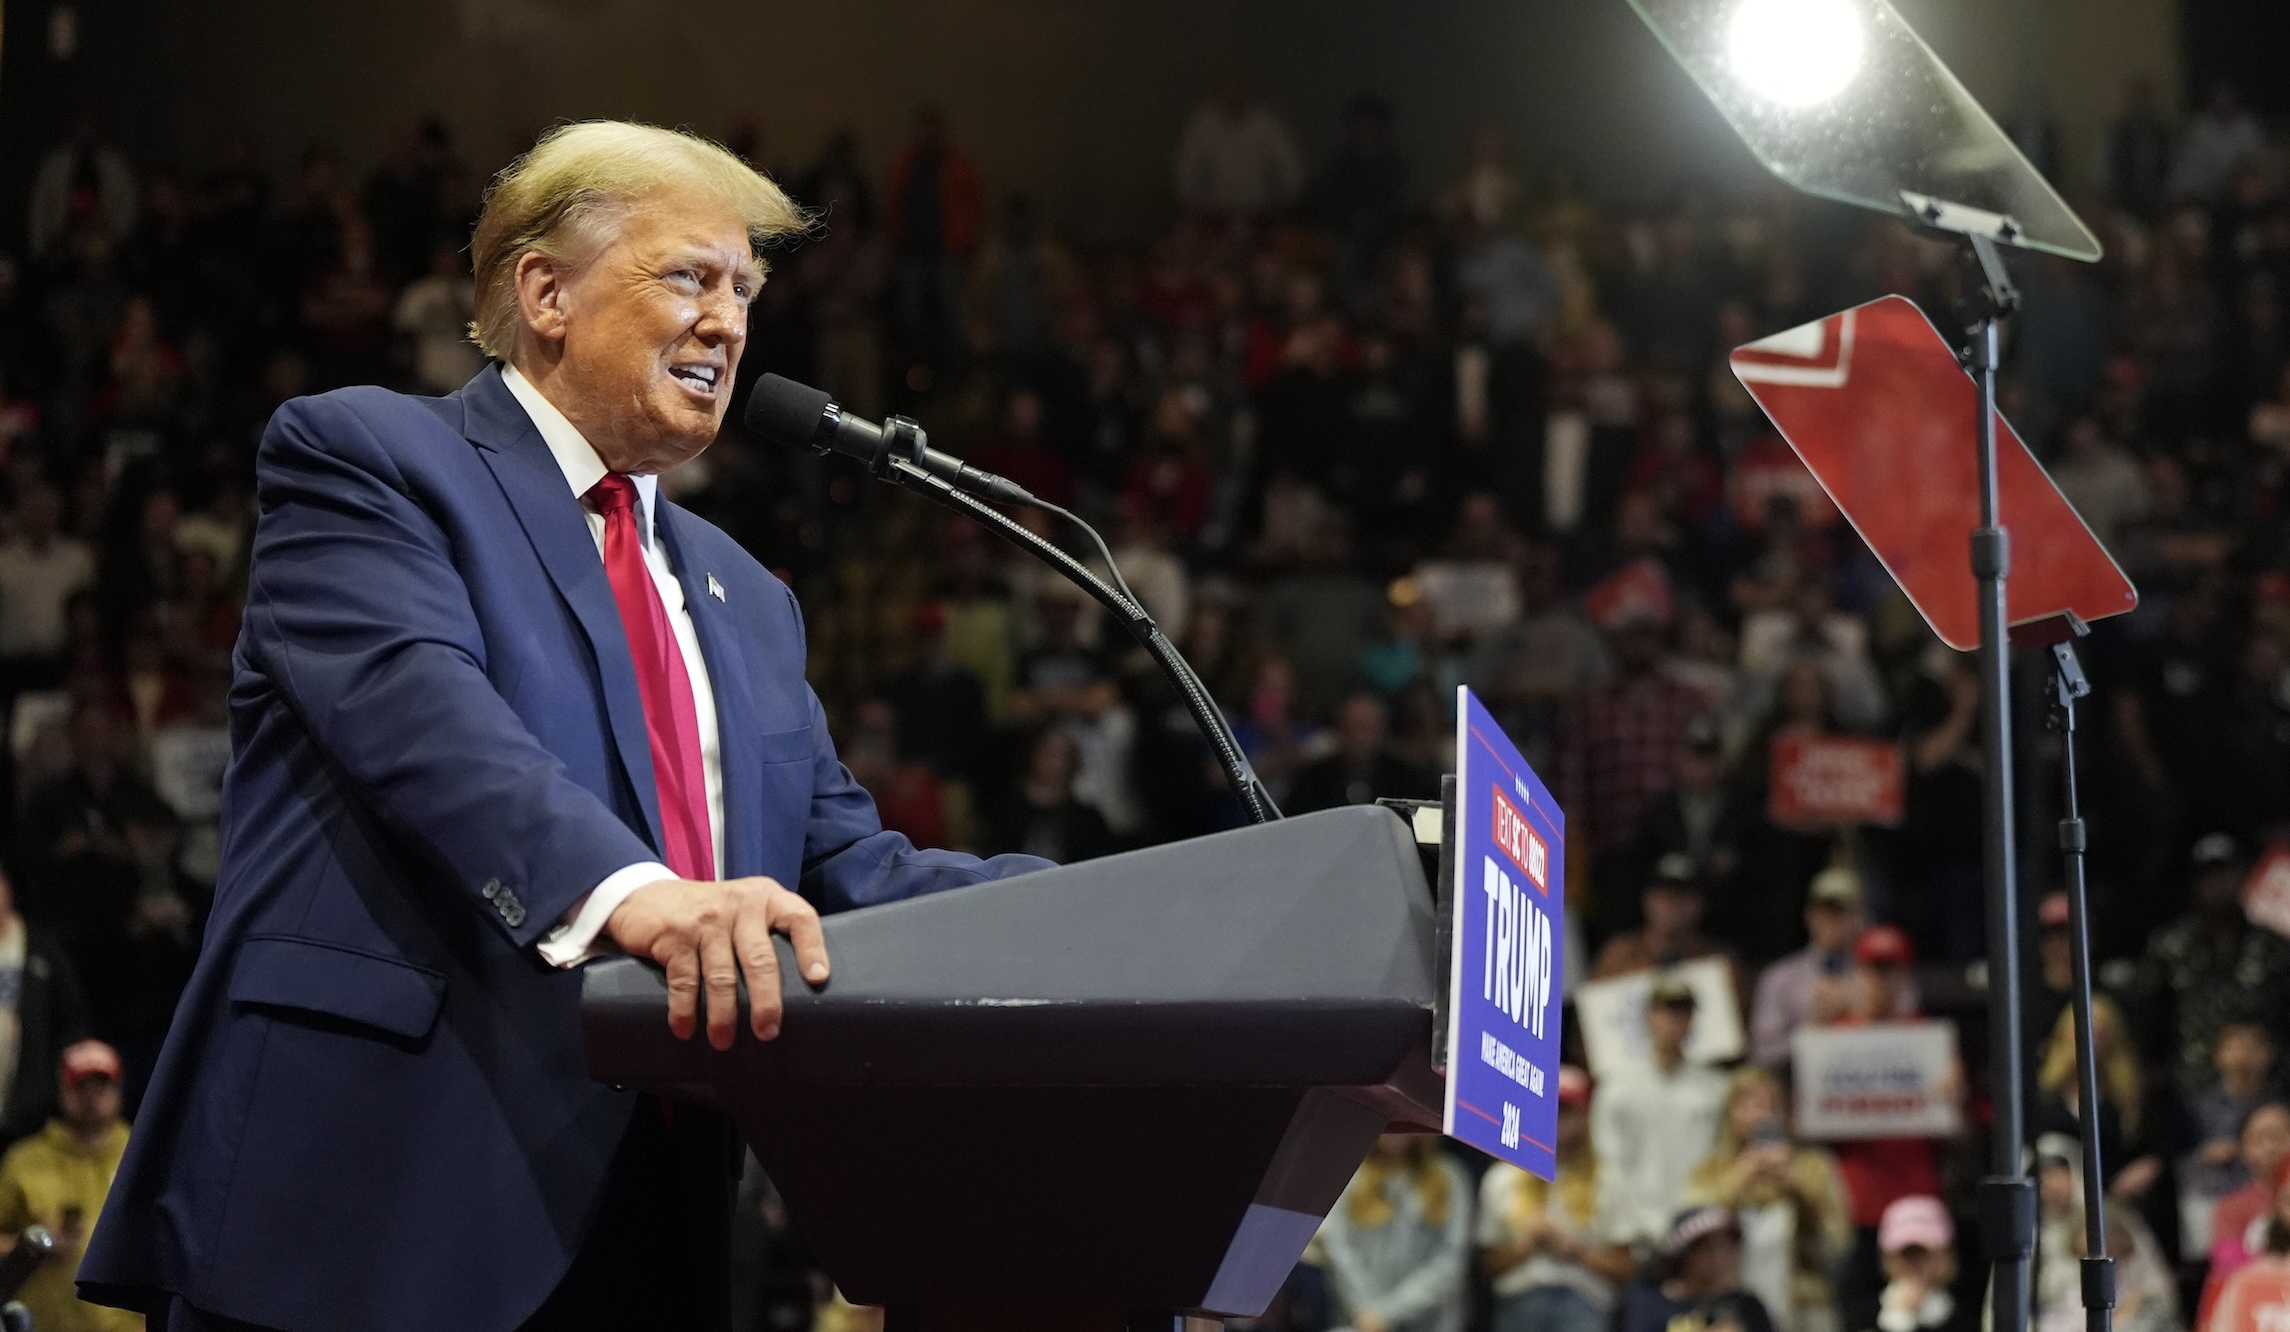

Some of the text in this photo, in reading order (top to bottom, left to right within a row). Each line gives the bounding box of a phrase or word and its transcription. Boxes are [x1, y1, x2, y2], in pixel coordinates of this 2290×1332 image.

[1497, 796, 1545, 888] TEXT SC TO 88022
[1484, 855, 1551, 1040] TRUMP
[1481, 1030, 1497, 1068] MAKE
[1495, 1040, 1516, 1080] AMERICA
[1515, 1054, 1530, 1089] GREAT
[1501, 1101, 1520, 1150] 2024
